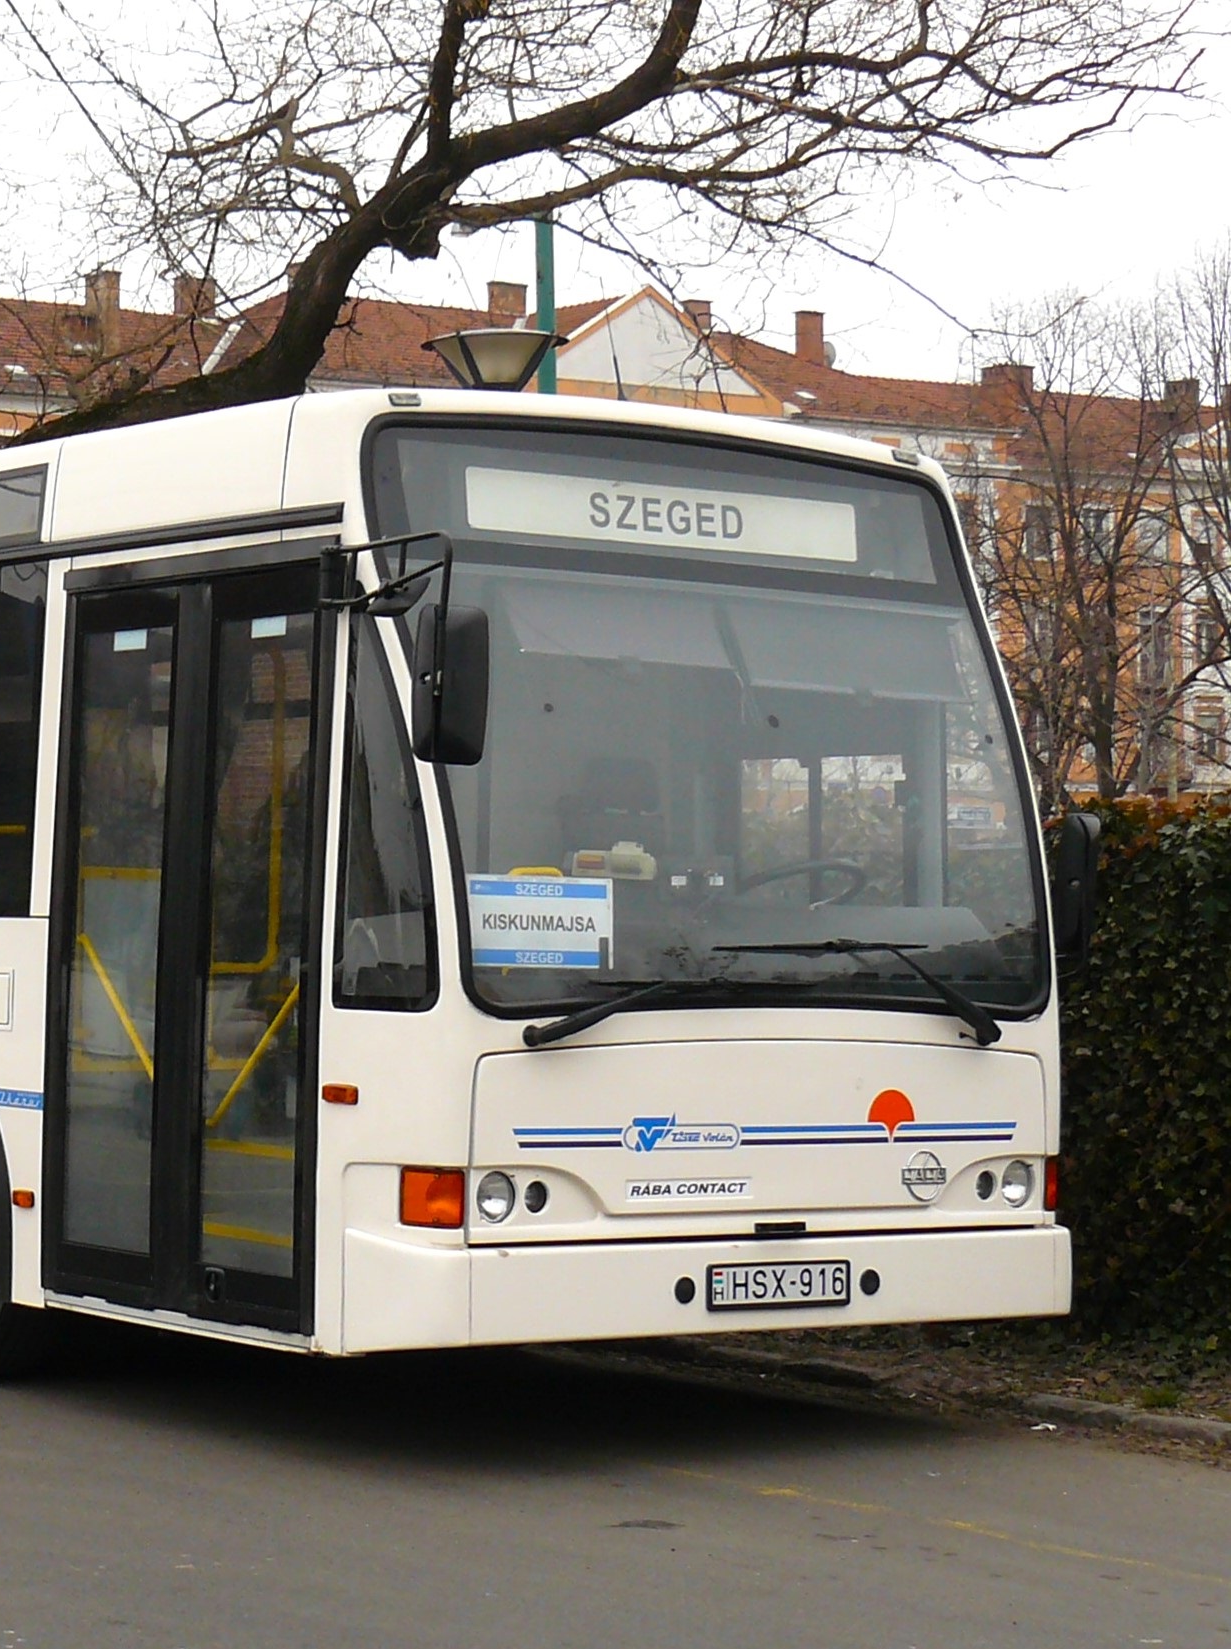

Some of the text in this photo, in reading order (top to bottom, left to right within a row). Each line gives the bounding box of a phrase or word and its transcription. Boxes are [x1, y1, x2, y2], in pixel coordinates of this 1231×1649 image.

[589, 492, 743, 539] SZEGED
[515, 883, 563, 896] SZEGED
[482, 913, 596, 932] KISKUNMAJSA
[515, 951, 563, 964] SZEGED
[630, 1182, 747, 1196] RÁBA CONTACT
[732, 1267, 844, 1300] HSX-916
